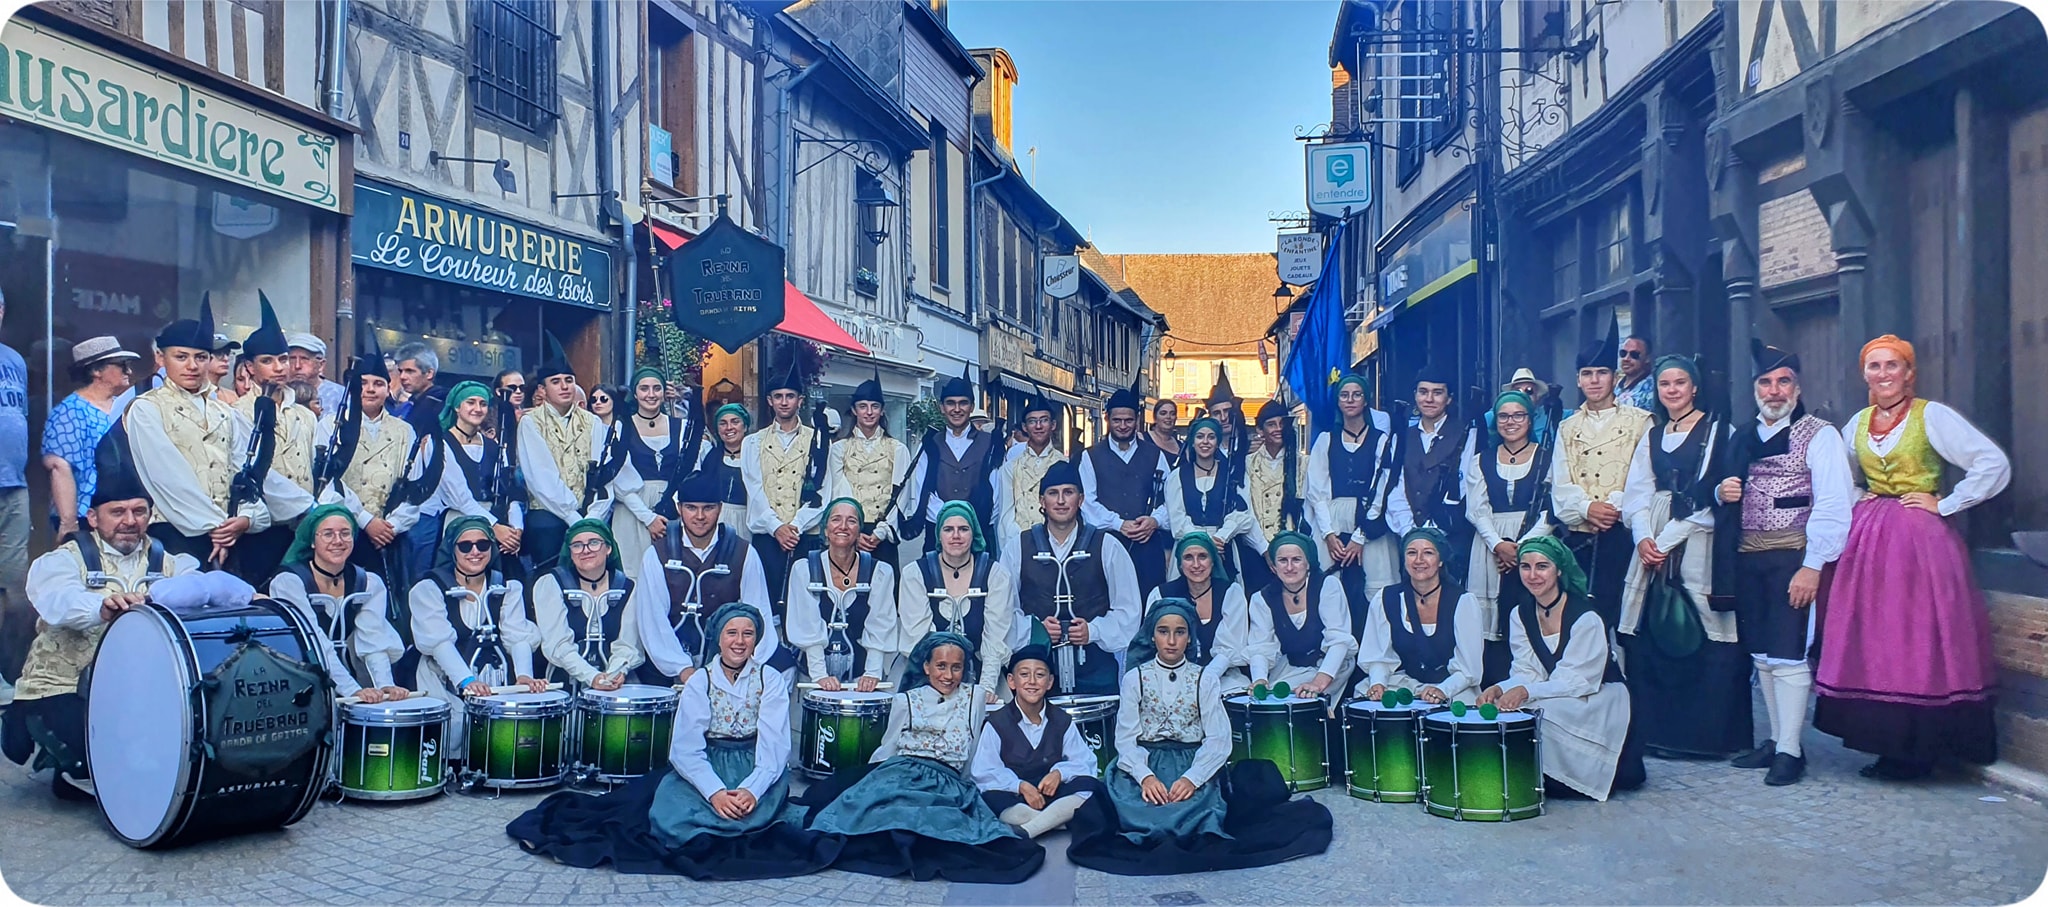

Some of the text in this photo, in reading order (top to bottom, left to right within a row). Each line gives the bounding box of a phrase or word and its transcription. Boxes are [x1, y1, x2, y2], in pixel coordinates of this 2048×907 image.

[1316, 189, 1364, 200] entendre
[395, 196, 583, 275] ARMURERIE
[370, 232, 595, 305] Le Coureur des Bois
[701, 259, 750, 277] REINA
[253, 667, 266, 676] LA
[233, 679, 291, 699] REINA
[818, 718, 836, 768] Pearl
[421, 738, 438, 783] Pearl
[217, 779, 287, 795] ASTURIAS
